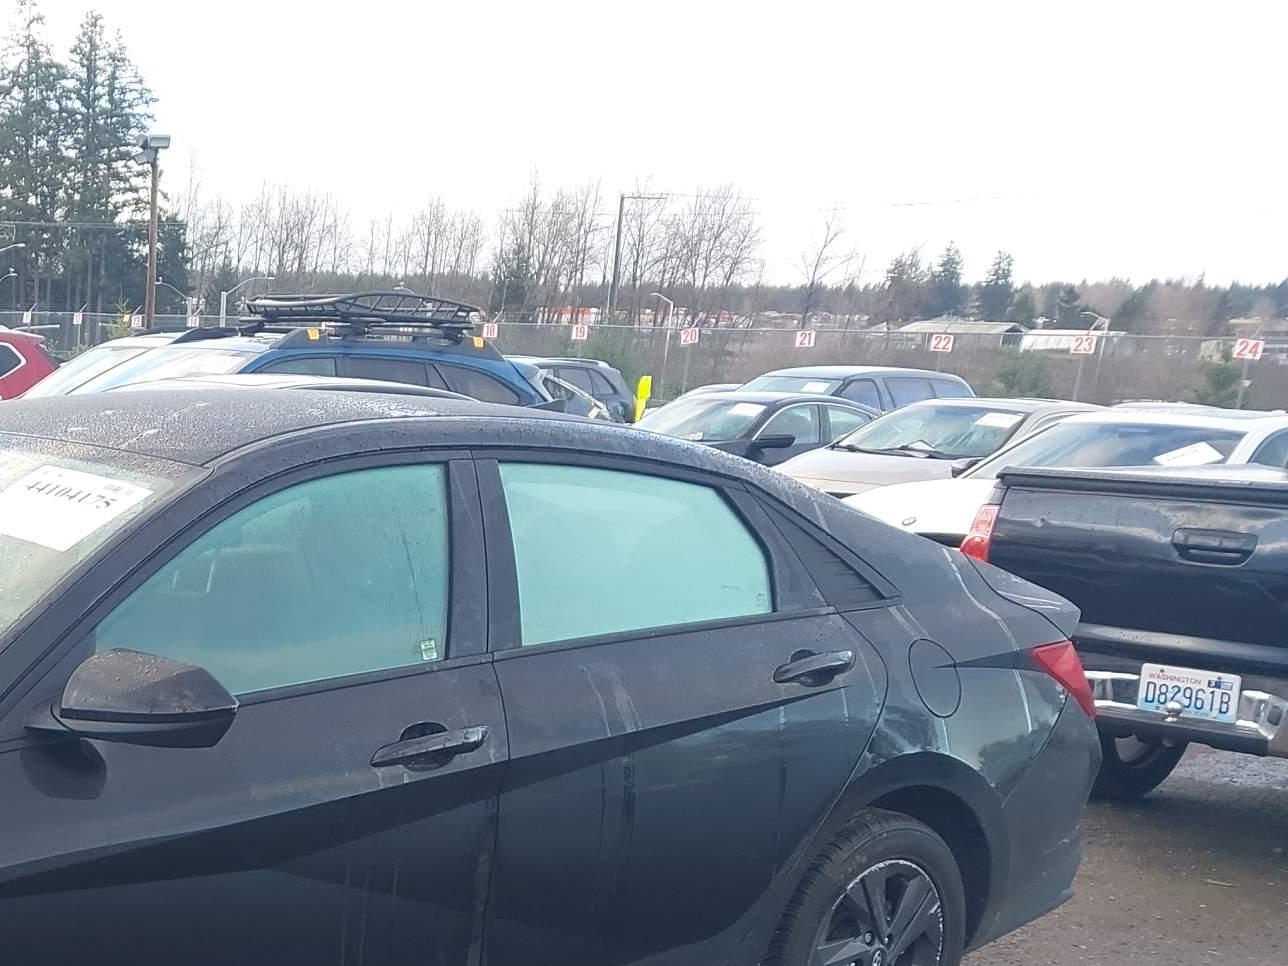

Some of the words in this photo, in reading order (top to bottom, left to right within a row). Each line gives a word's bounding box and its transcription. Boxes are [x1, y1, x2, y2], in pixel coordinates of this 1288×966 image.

[133, 316, 142, 326] 13
[574, 325, 586, 338] 19
[683, 329, 698, 343] 20
[797, 332, 815, 347] 21
[932, 335, 952, 352] 22
[1072, 337, 1096, 354] 23
[1236, 340, 1261, 358] 24
[25, 480, 118, 509] 44104175
[1148, 671, 1202, 686] WASHINGTON
[1144, 680, 1231, 714] D82961B
